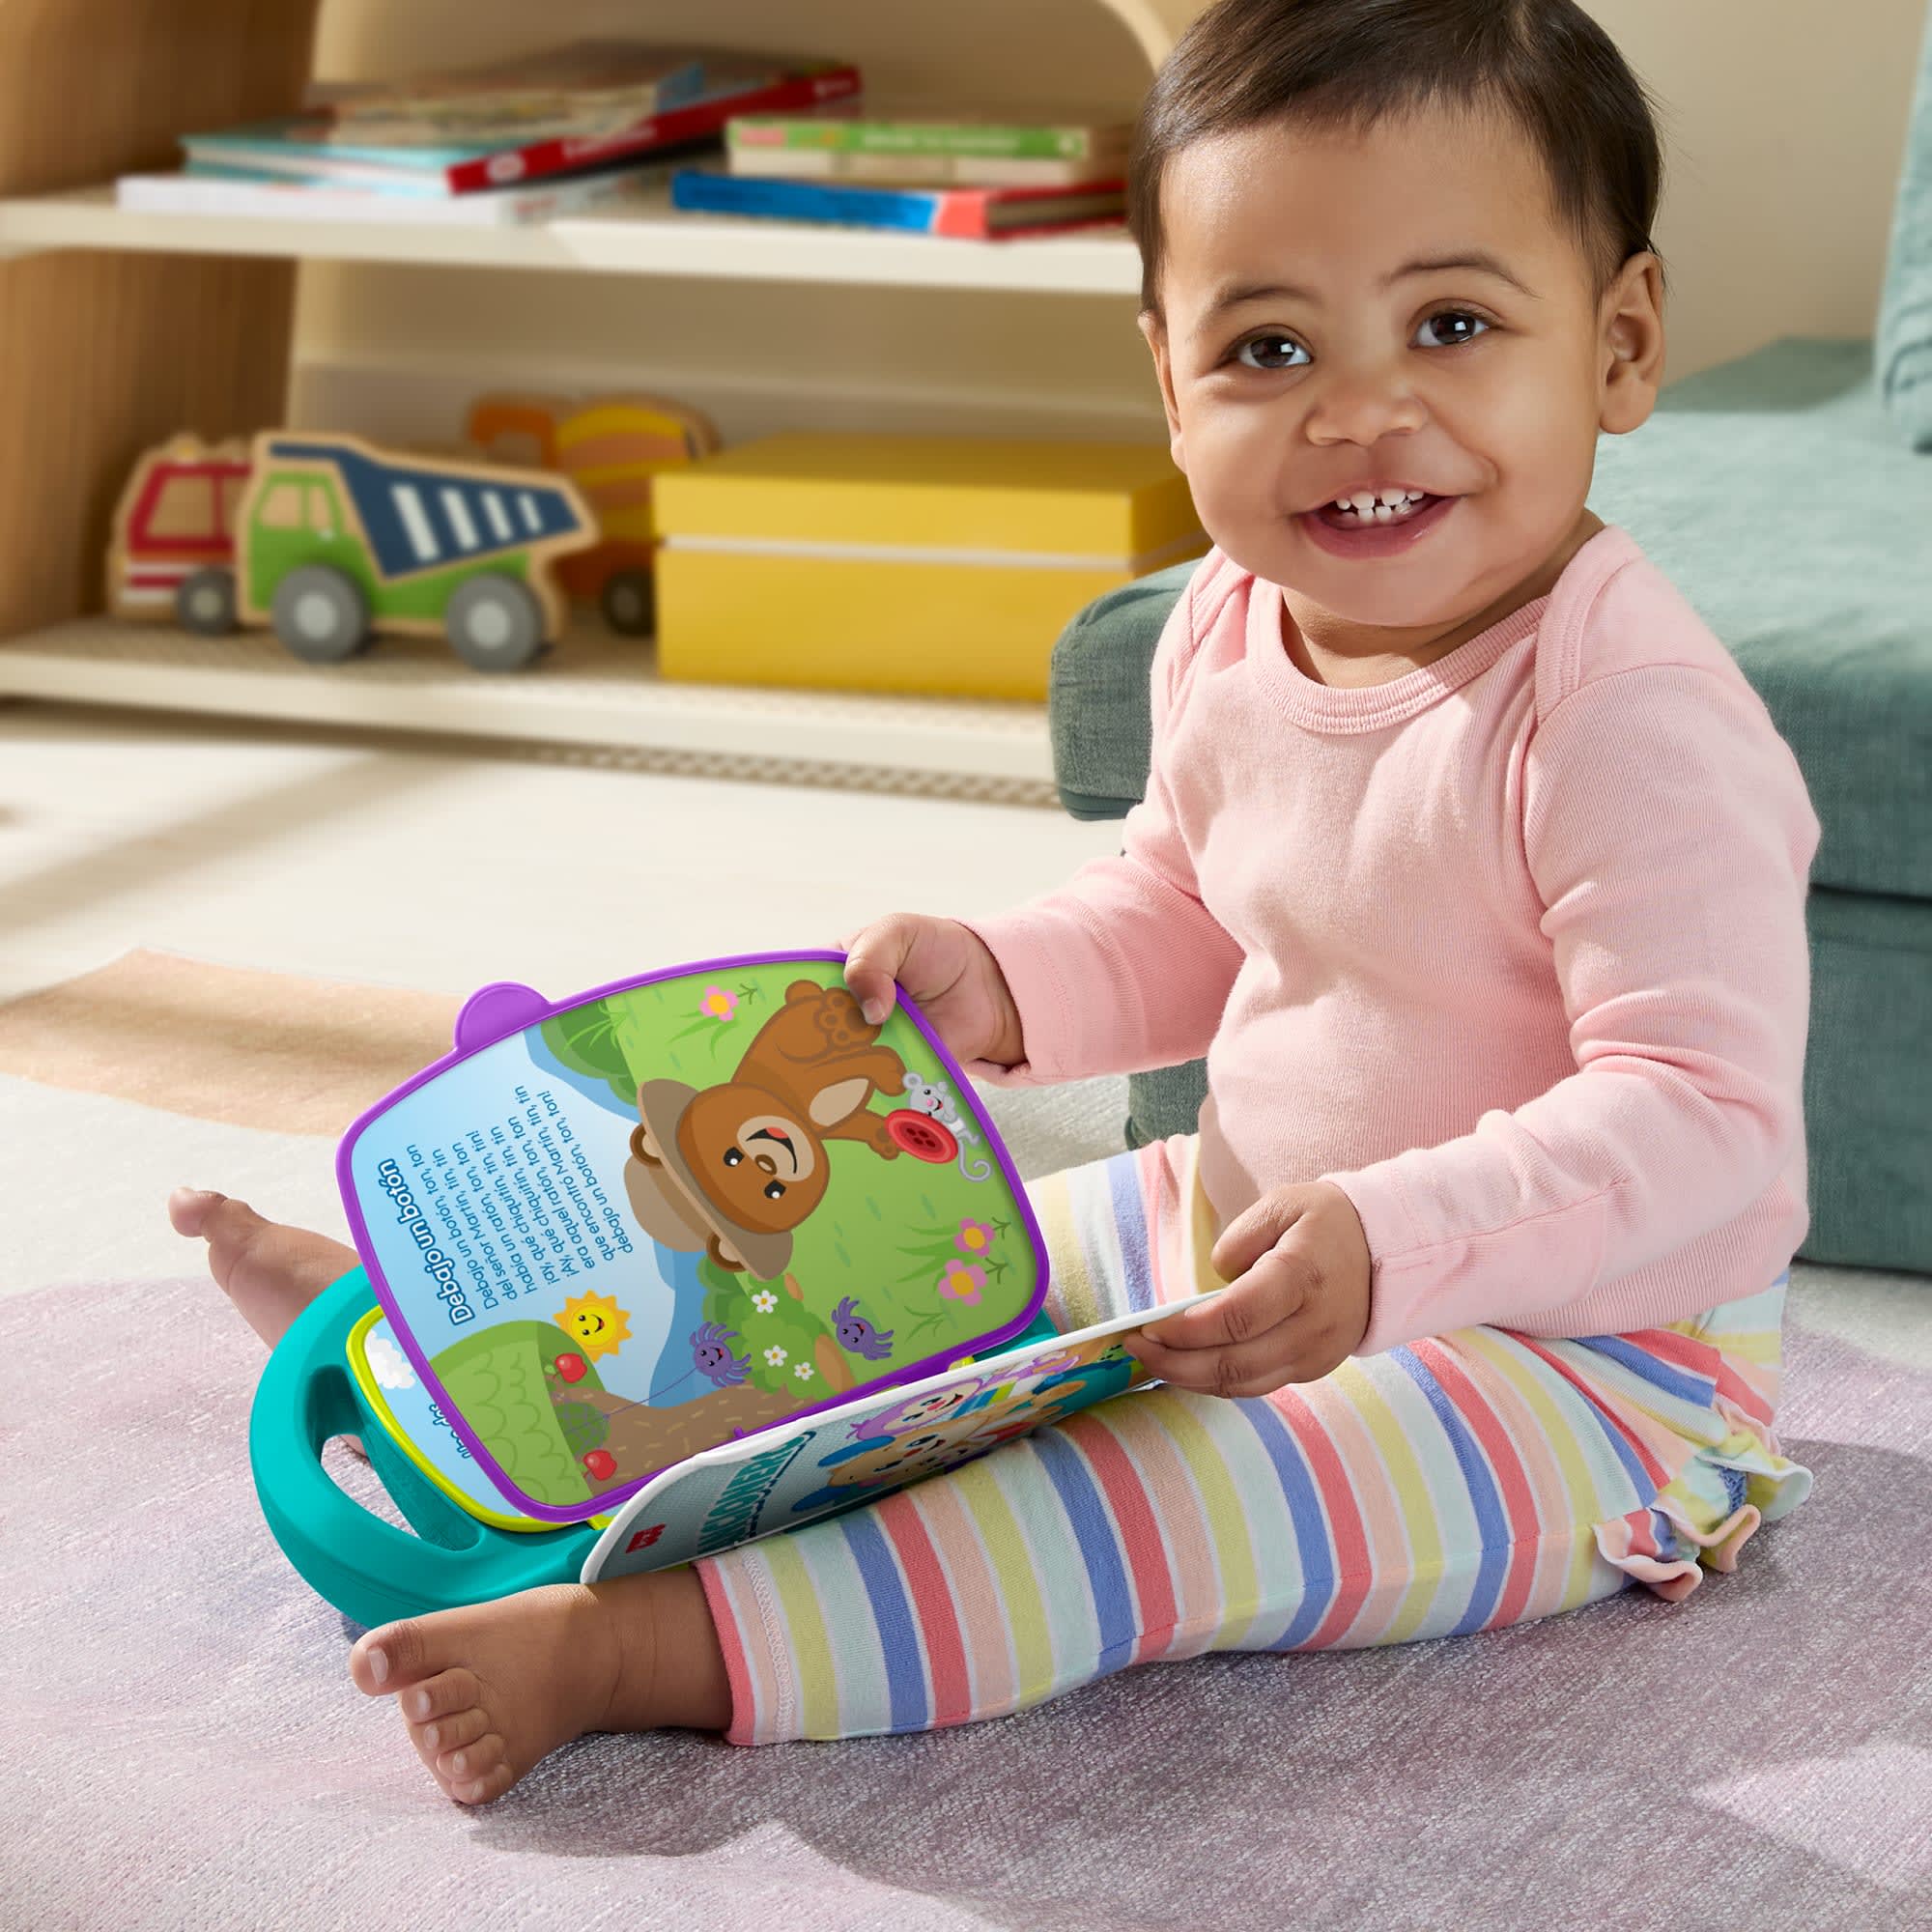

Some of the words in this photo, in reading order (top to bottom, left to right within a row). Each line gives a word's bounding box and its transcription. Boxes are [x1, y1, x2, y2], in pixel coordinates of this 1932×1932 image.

[515, 1086, 530, 1104] tin
[536, 1091, 560, 1117] ton!
[508, 1117, 526, 1139] ton
[526, 1105, 542, 1125] tin,
[466, 1130, 486, 1151] tin!
[491, 1126, 505, 1145] tin
[556, 1117, 575, 1144] ton,
[407, 1145, 424, 1167] ton
[433, 1149, 447, 1167] tin
[452, 1142, 470, 1165] ton
[483, 1152, 498, 1175] tin,
[502, 1146, 518, 1167] tin,
[523, 1140, 540, 1166] ton,
[538, 1127, 568, 1175] Martín,
[444, 1168, 459, 1190] tin,
[467, 1166, 484, 1192] ton,
[571, 1144, 598, 1188] botón,
[378, 1158, 422, 1225] botón
[421, 1168, 439, 1195] ton,
[536, 1167, 561, 1206] ratón,
[495, 1176, 529, 1234] chiquitín,
[514, 1168, 549, 1226] chiquitín,
[559, 1176, 600, 1234] encontró
[592, 1187, 608, 1206] un
[435, 1195, 462, 1240] botón,
[456, 1190, 486, 1239] Martín,
[481, 1190, 505, 1232] ratón,
[410, 1219, 436, 1251] un
[552, 1207, 582, 1244] aquel
[603, 1208, 633, 1253] debajo
[457, 1239, 471, 1258] un
[500, 1234, 516, 1252] un
[522, 1236, 545, 1261] qué
[541, 1229, 564, 1253] qué
[595, 1236, 615, 1261] que
[480, 1242, 505, 1277] señor
[559, 1255, 580, 1277] ¡Ay,
[577, 1246, 595, 1268] era
[468, 1260, 498, 1310] Debajo
[510, 1253, 537, 1293] había
[540, 1263, 560, 1285] ¡ay,
[424, 1248, 475, 1326] Debajo
[496, 1279, 518, 1299] del
